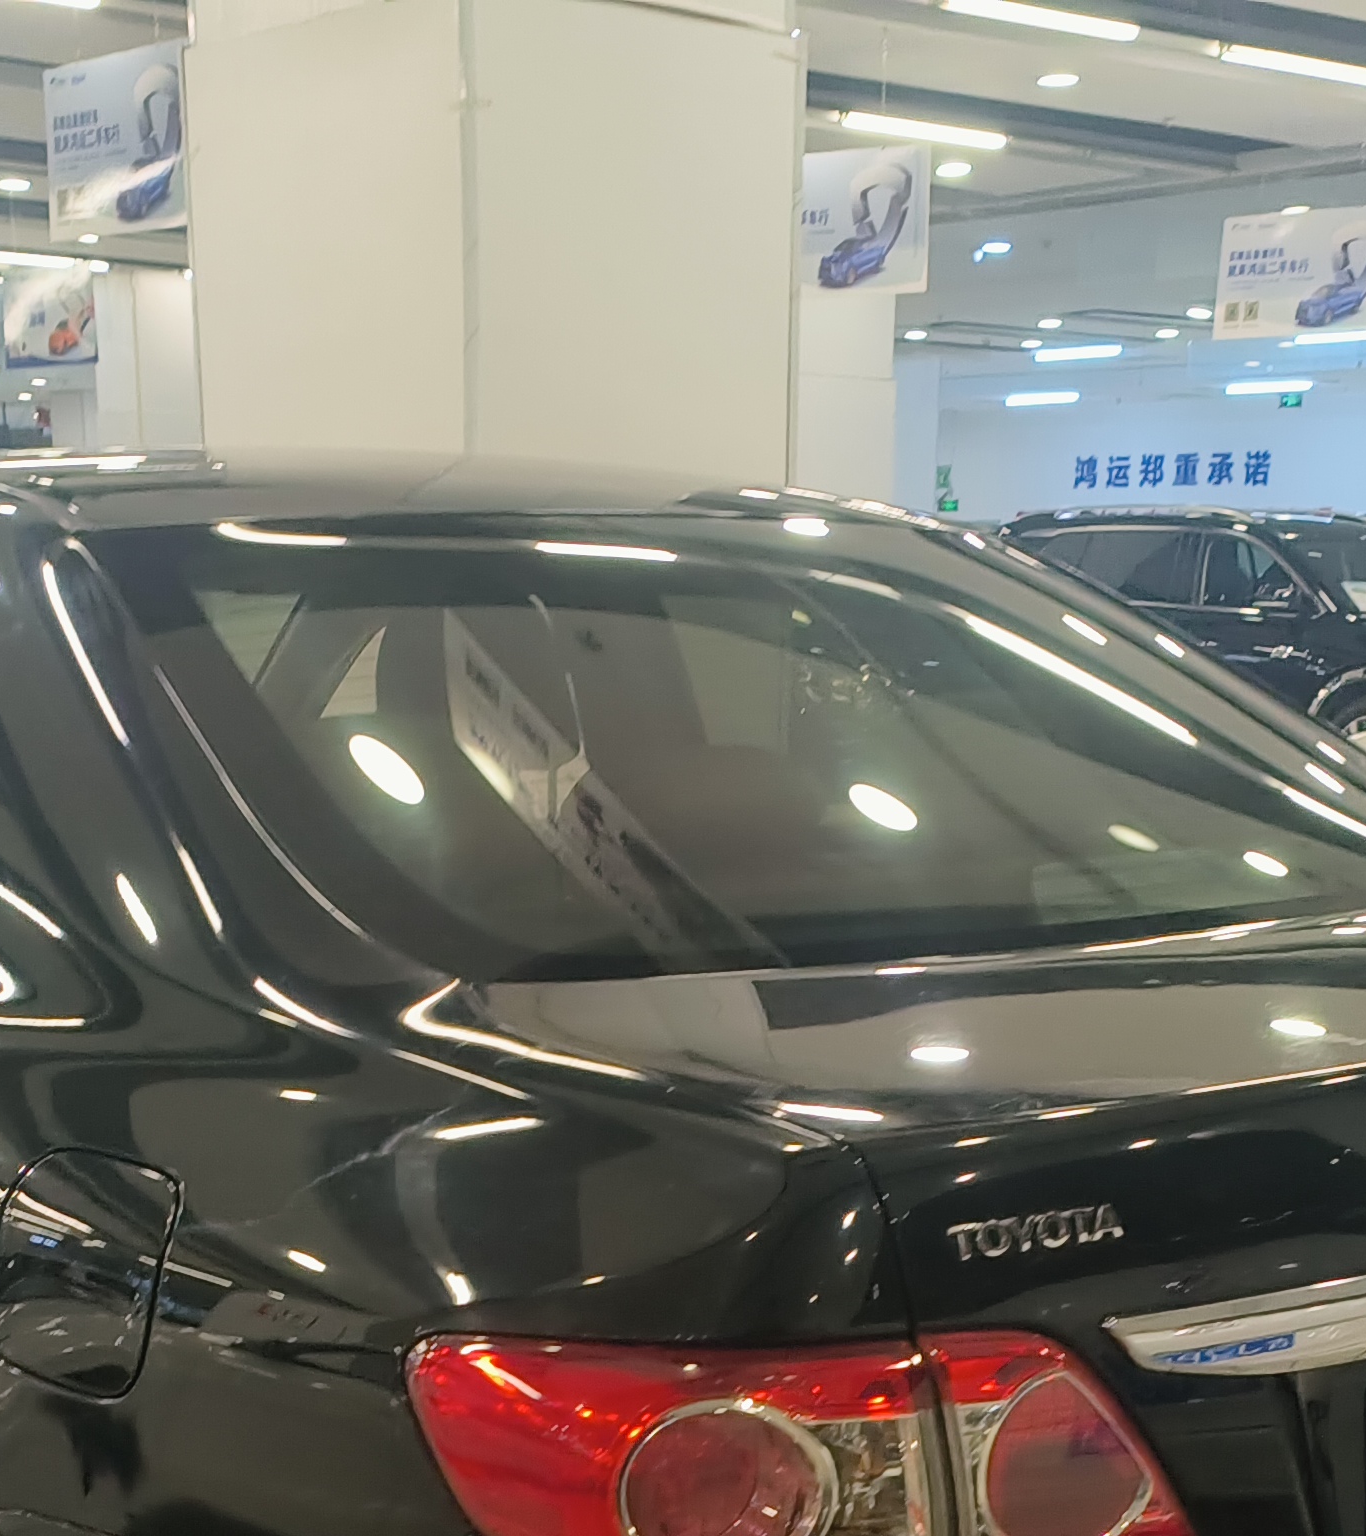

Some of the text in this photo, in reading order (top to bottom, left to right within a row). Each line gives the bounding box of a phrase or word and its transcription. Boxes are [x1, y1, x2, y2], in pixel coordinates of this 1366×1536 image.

[1073, 450, 1271, 489] 鸿运郑重承诺
[946, 1203, 1124, 1261] TOYOTA
